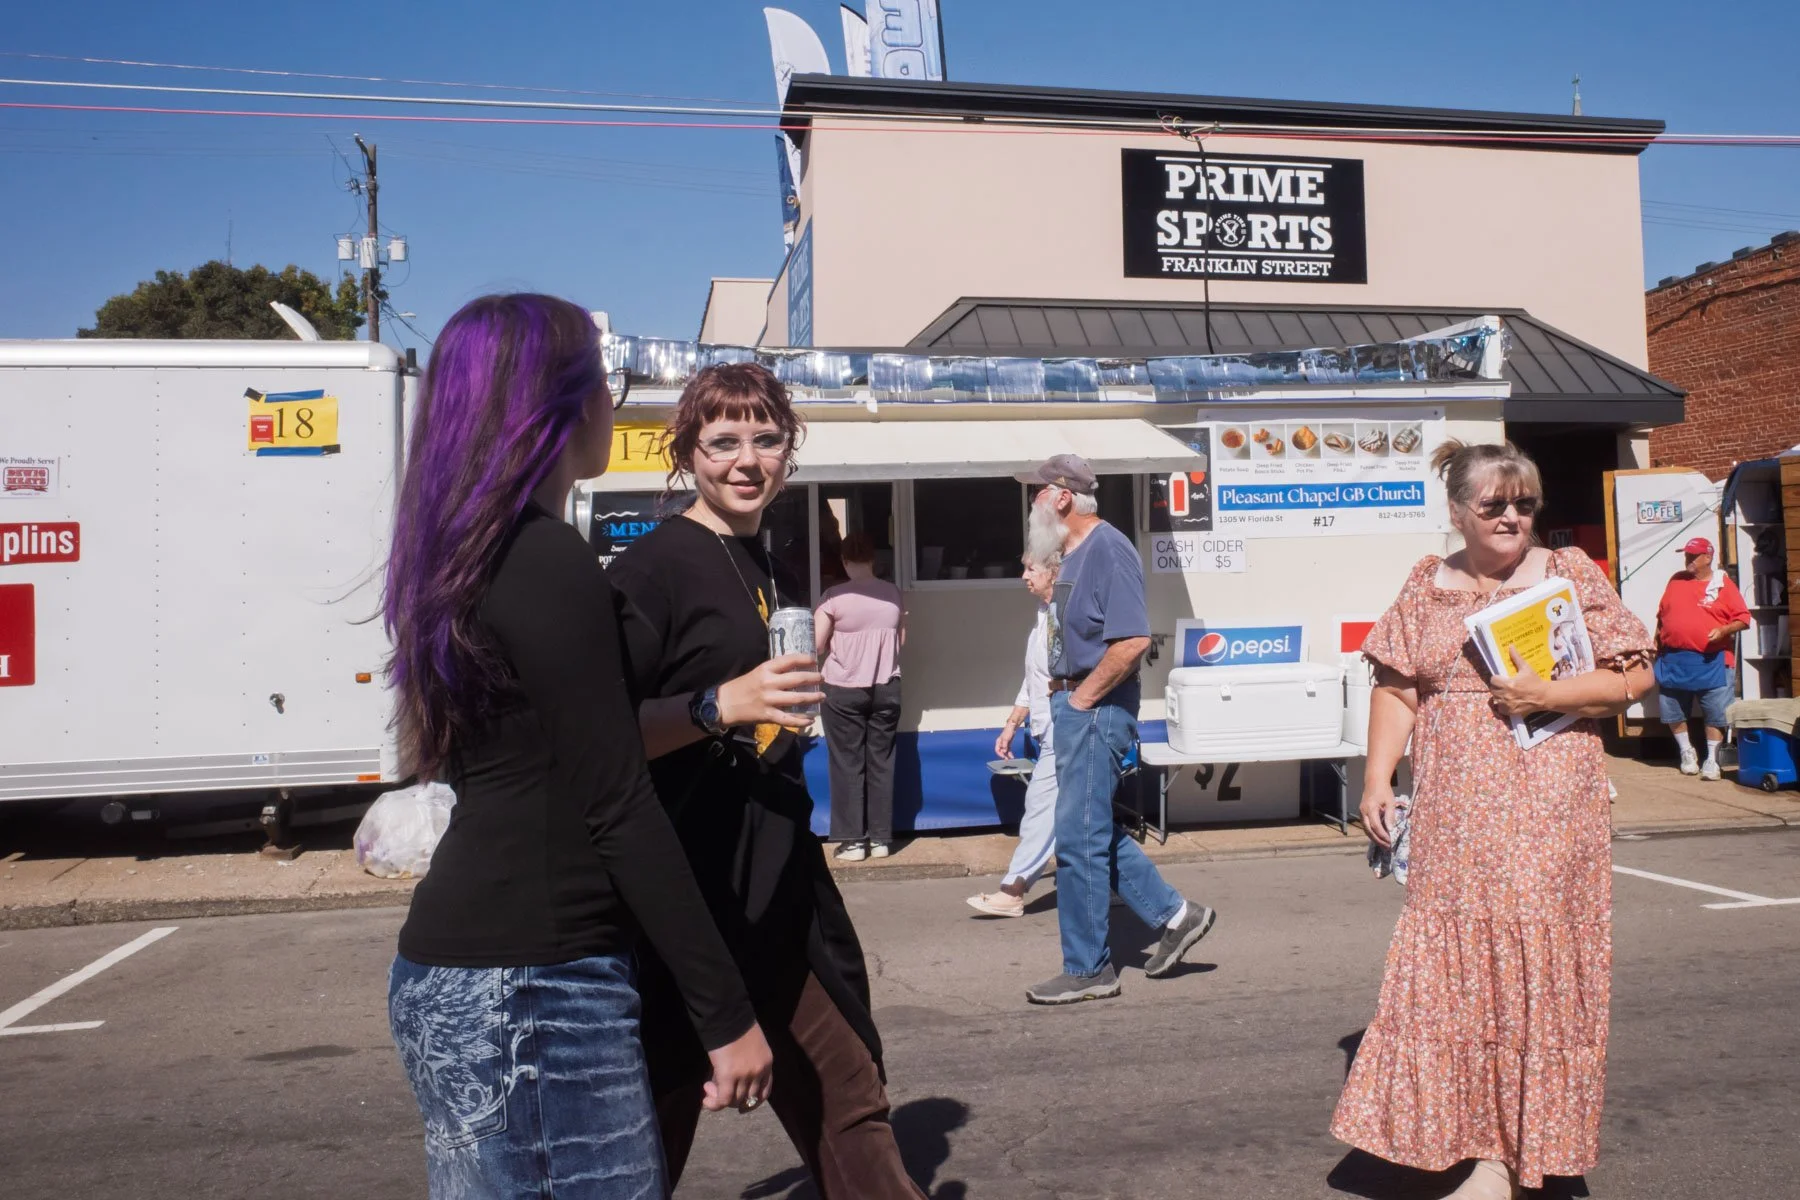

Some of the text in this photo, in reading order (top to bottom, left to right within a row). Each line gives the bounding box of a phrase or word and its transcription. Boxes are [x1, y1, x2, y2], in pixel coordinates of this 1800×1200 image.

[1164, 163, 1325, 205] PRIME
[1161, 256, 1331, 276] FRANKLIN STREET
[275, 407, 314, 439] 18
[620, 431, 656, 461] 17
[10, 456, 35, 465] Proudly
[1222, 484, 1421, 507] Pleasant Chapel GB Church
[1248, 515, 1274, 523] Florida
[1275, 514, 1283, 522] St
[1313, 515, 1335, 527] #17
[1641, 505, 1681, 520] COFFEE
[610, 522, 661, 537] MEN
[0, 525, 74, 562] plins
[1156, 540, 1244, 553] CASH CIDER
[1157, 555, 1232, 569] ONLY $5
[1230, 635, 1291, 659] pepsi
